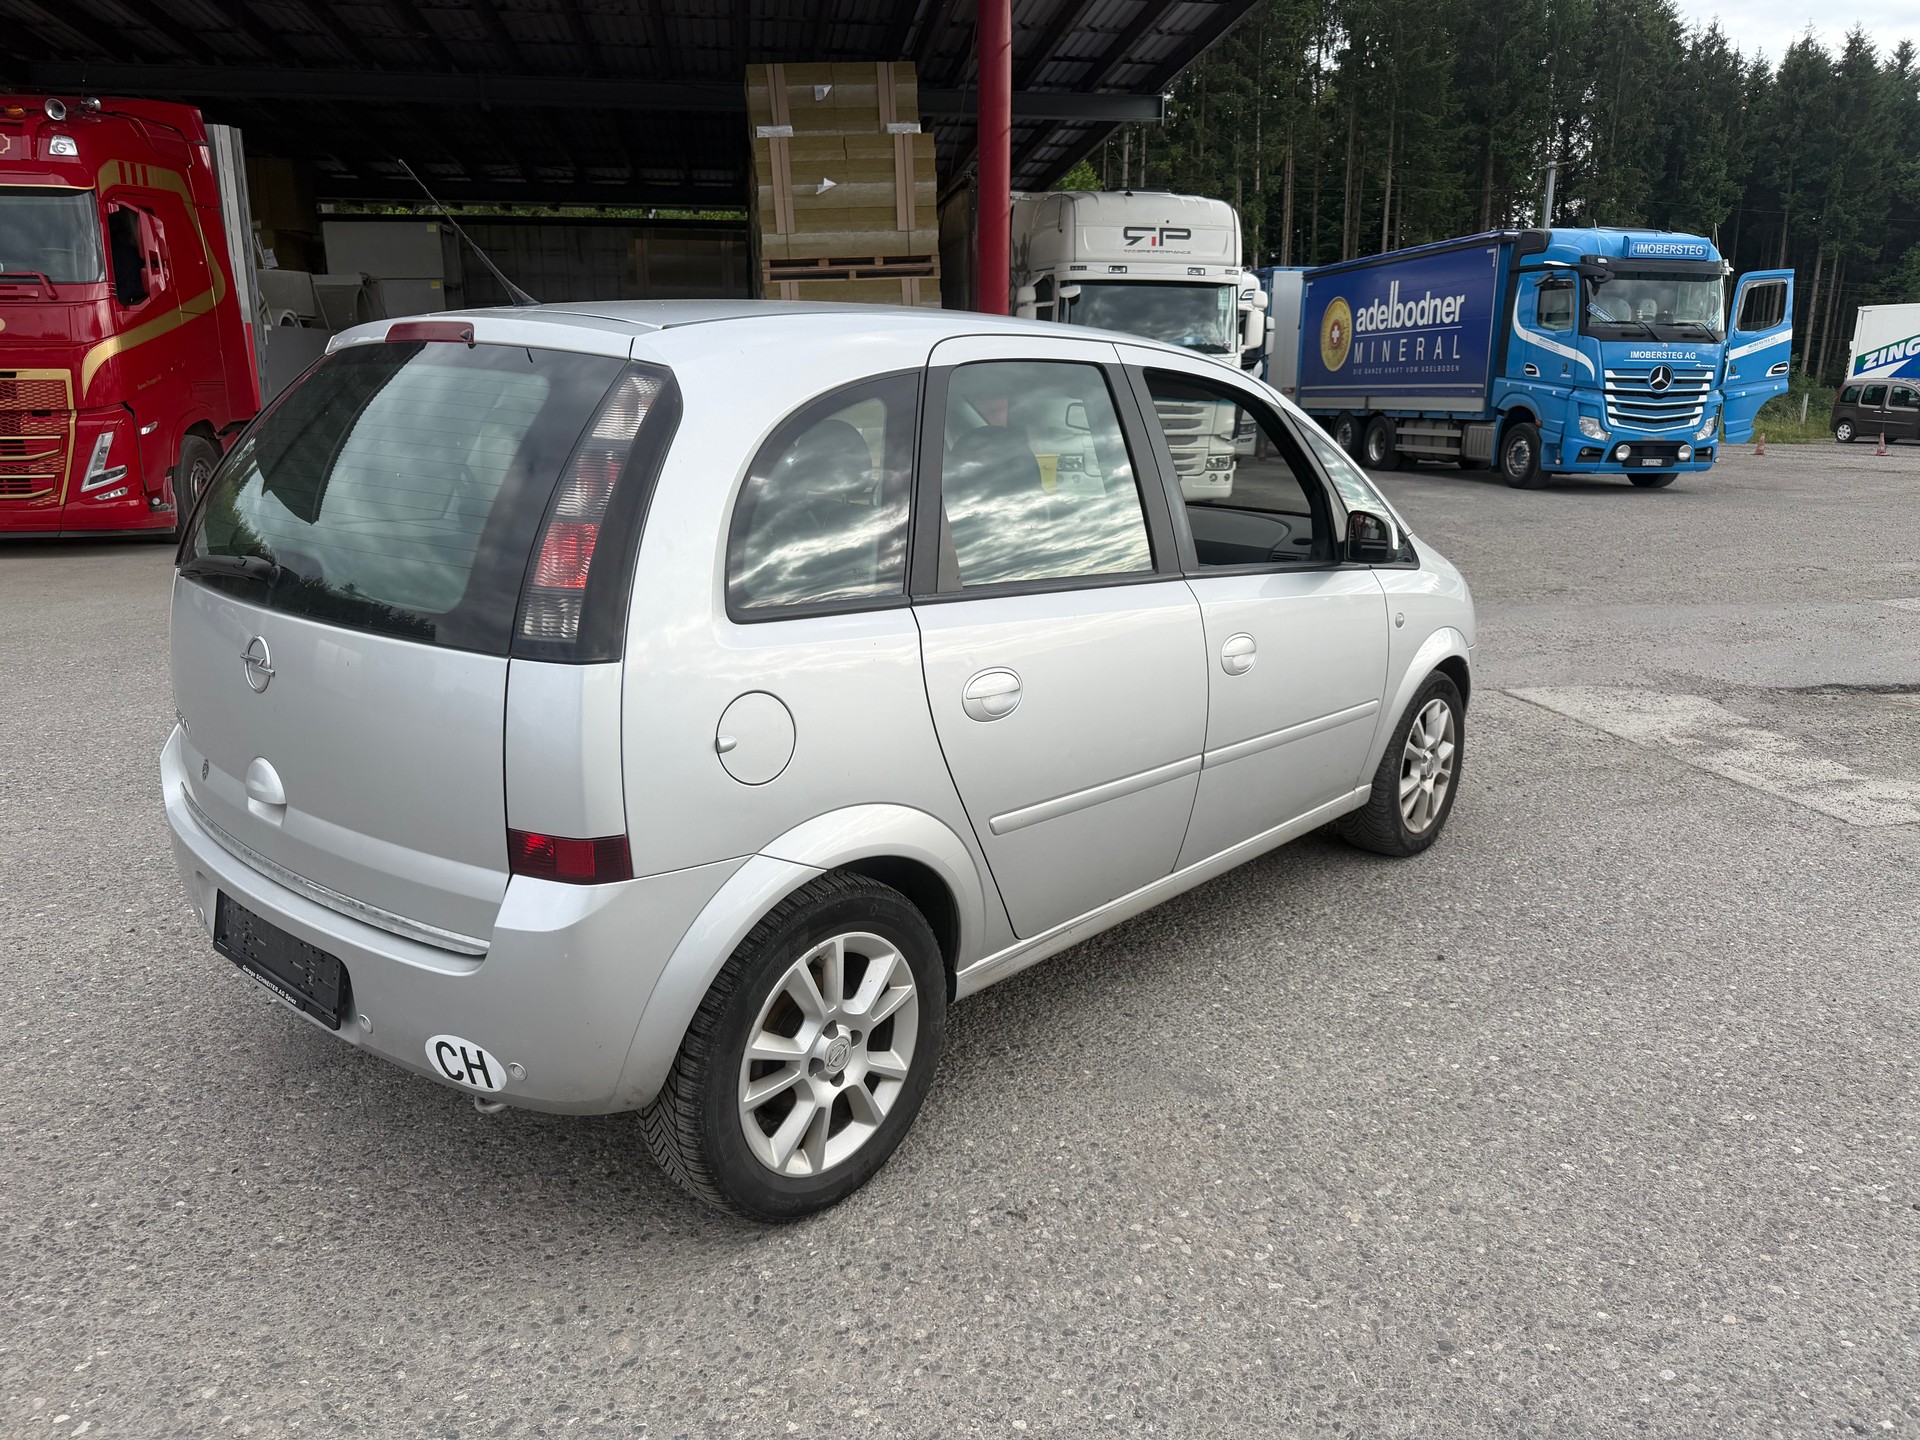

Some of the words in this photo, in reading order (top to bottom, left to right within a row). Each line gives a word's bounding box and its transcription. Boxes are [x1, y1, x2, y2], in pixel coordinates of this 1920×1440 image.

[1636, 243, 1703, 255] IMOBERSTEG
[1356, 280, 1465, 332] adelbodner
[1353, 335, 1460, 364] MINERAL
[1630, 350, 1683, 359] IMOBERSTEG
[1684, 351, 1696, 360] AG
[435, 1040, 494, 1089] CH
